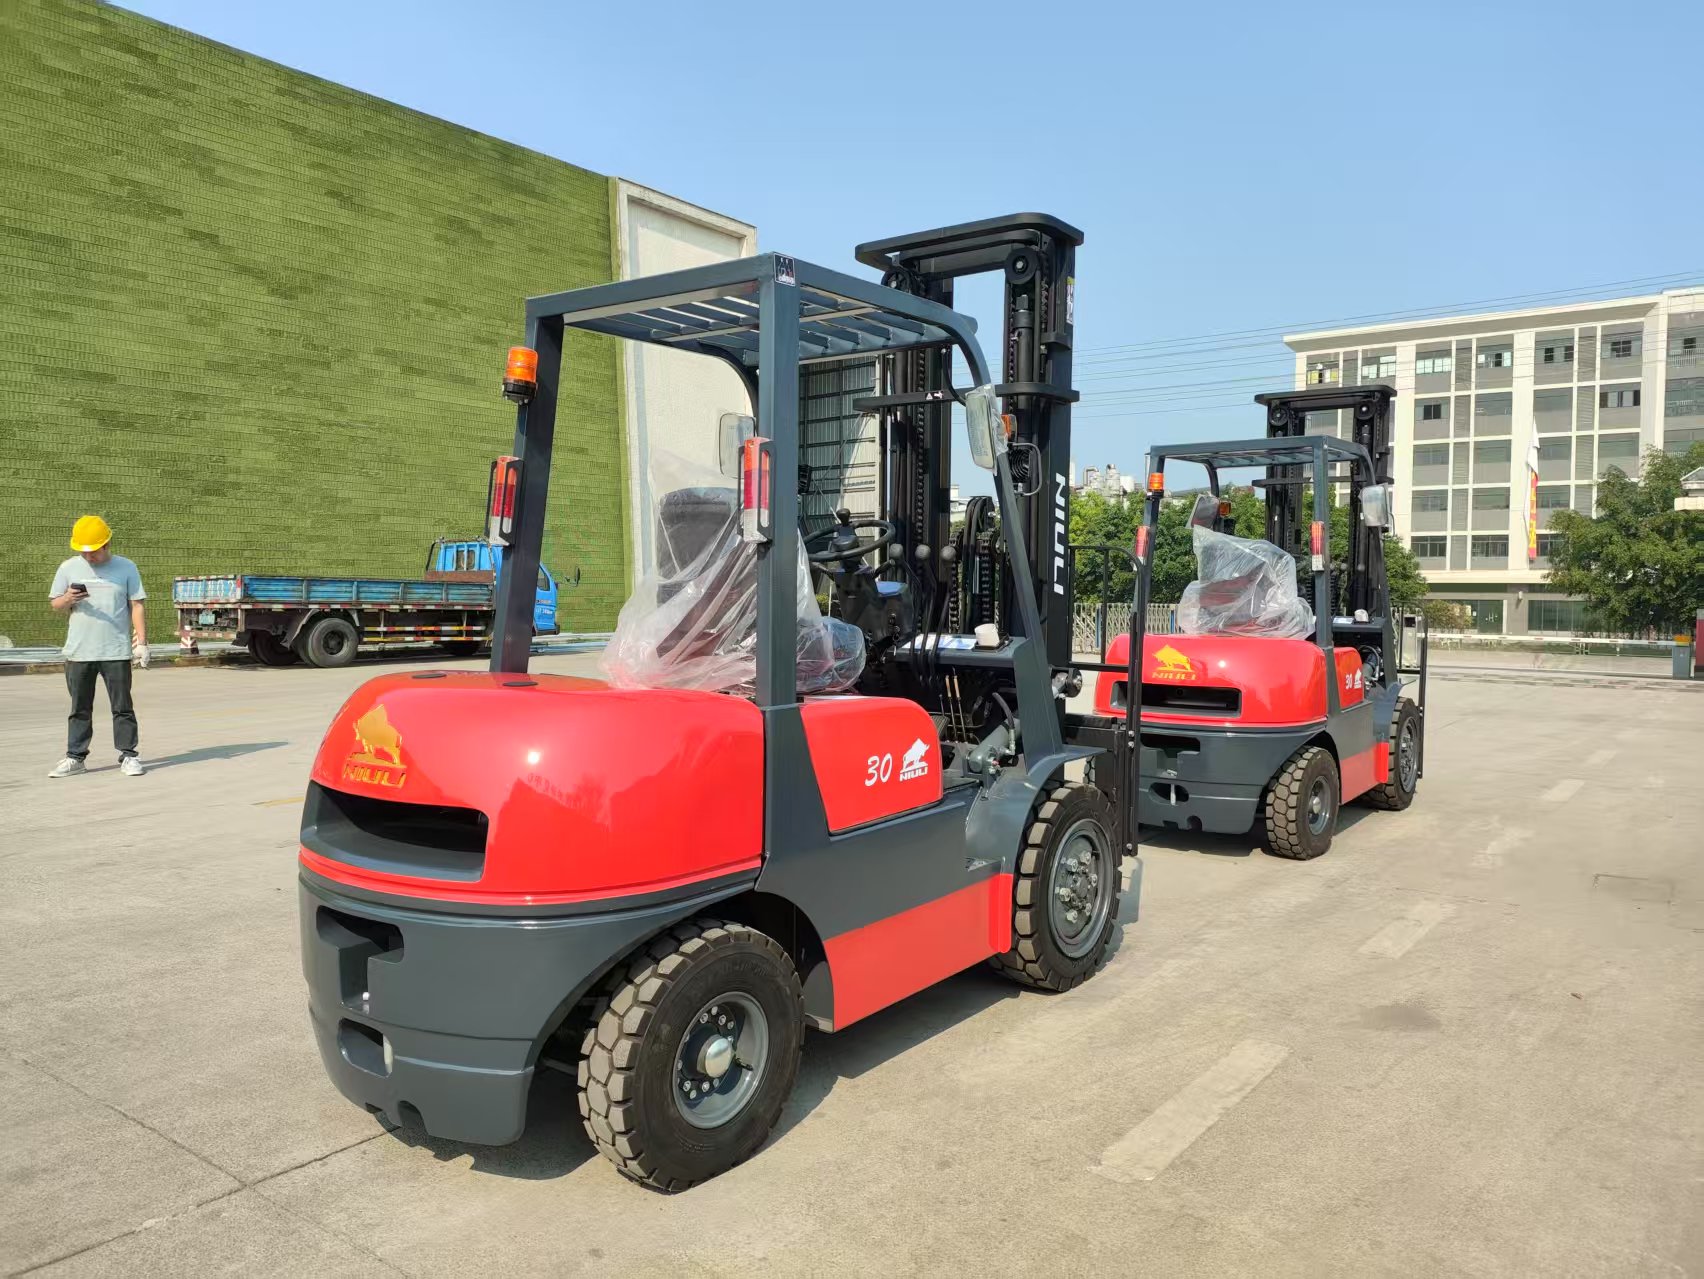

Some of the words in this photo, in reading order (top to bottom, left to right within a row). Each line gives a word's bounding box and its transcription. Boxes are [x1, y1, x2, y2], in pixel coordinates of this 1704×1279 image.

[1053, 472, 1066, 596] NIULI
[343, 764, 407, 788] NIULI
[864, 752, 893, 787] 30
[899, 766, 928, 782] NIULI
